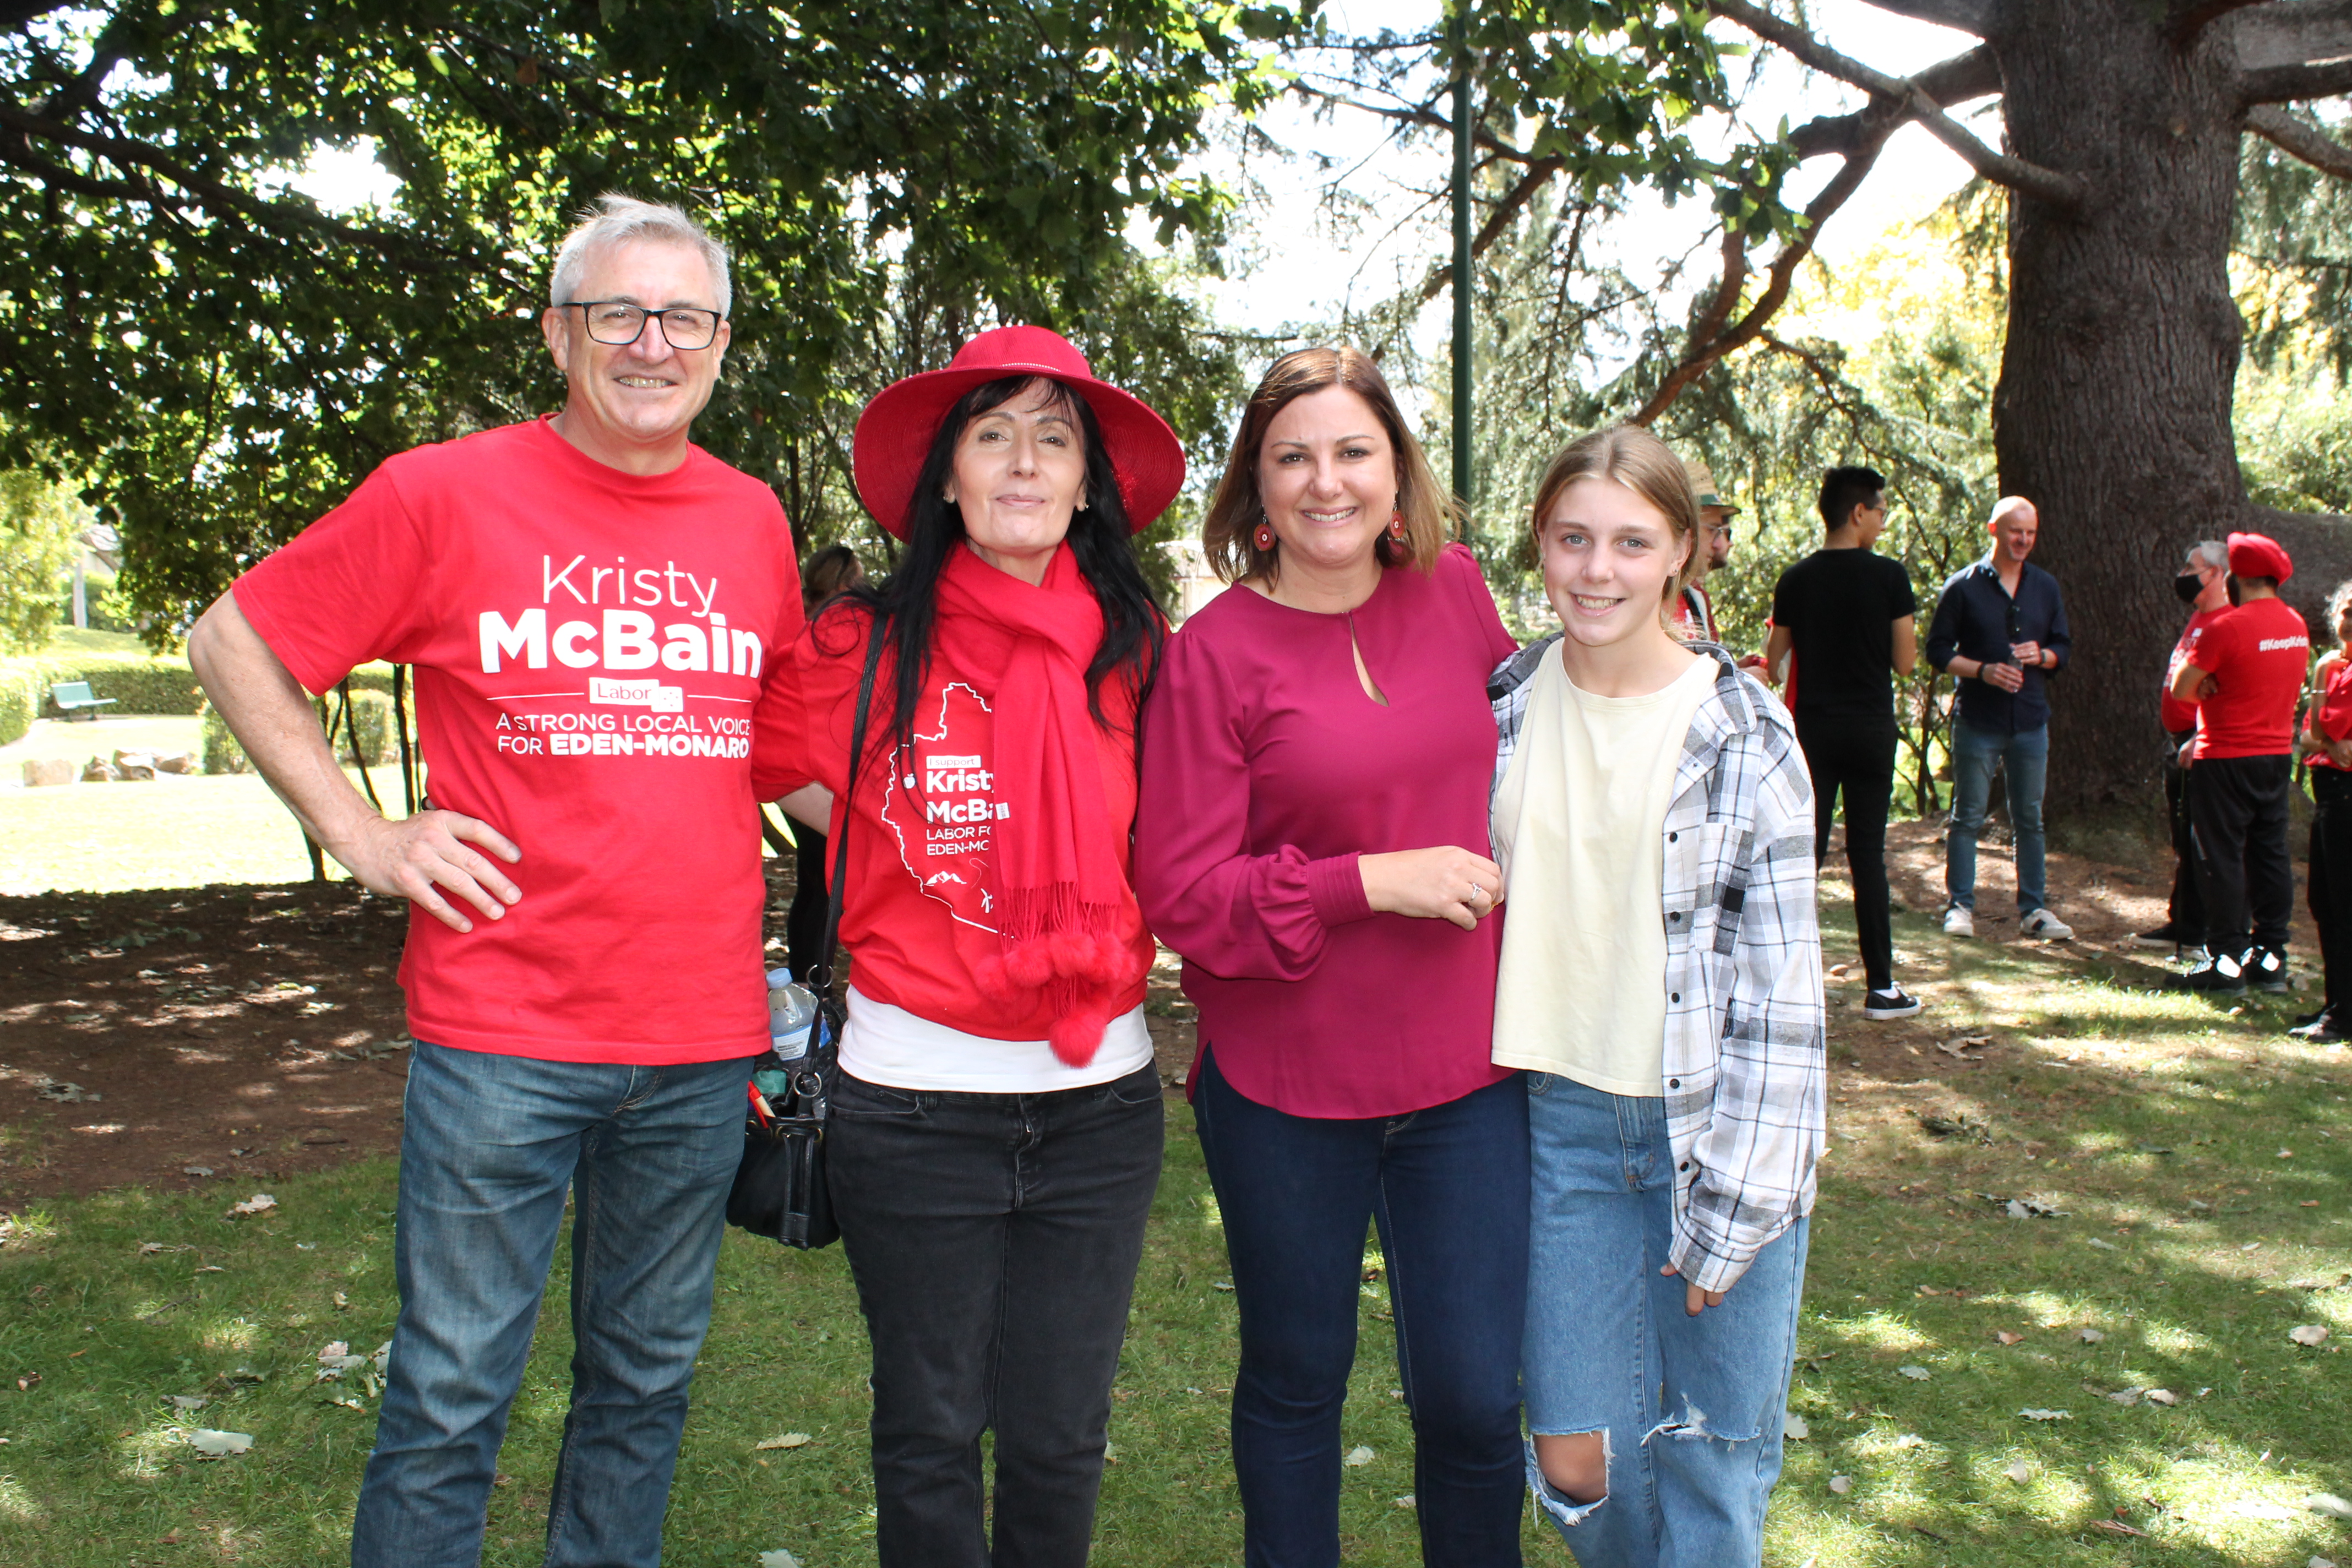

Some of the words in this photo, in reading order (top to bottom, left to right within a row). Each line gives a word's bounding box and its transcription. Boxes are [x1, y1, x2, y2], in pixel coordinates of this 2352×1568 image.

[543, 554, 717, 617] Kristy
[479, 608, 763, 678] McBain
[597, 683, 652, 700] Labor
[496, 712, 511, 731] A
[513, 713, 616, 732] STRONG
[623, 715, 703, 732] LOCAL
[707, 716, 750, 736] VOICE
[498, 735, 543, 755] FOR
[549, 733, 749, 759] EDEN-MONARO
[935, 758, 976, 767] support
[926, 826, 975, 840] LABOR
